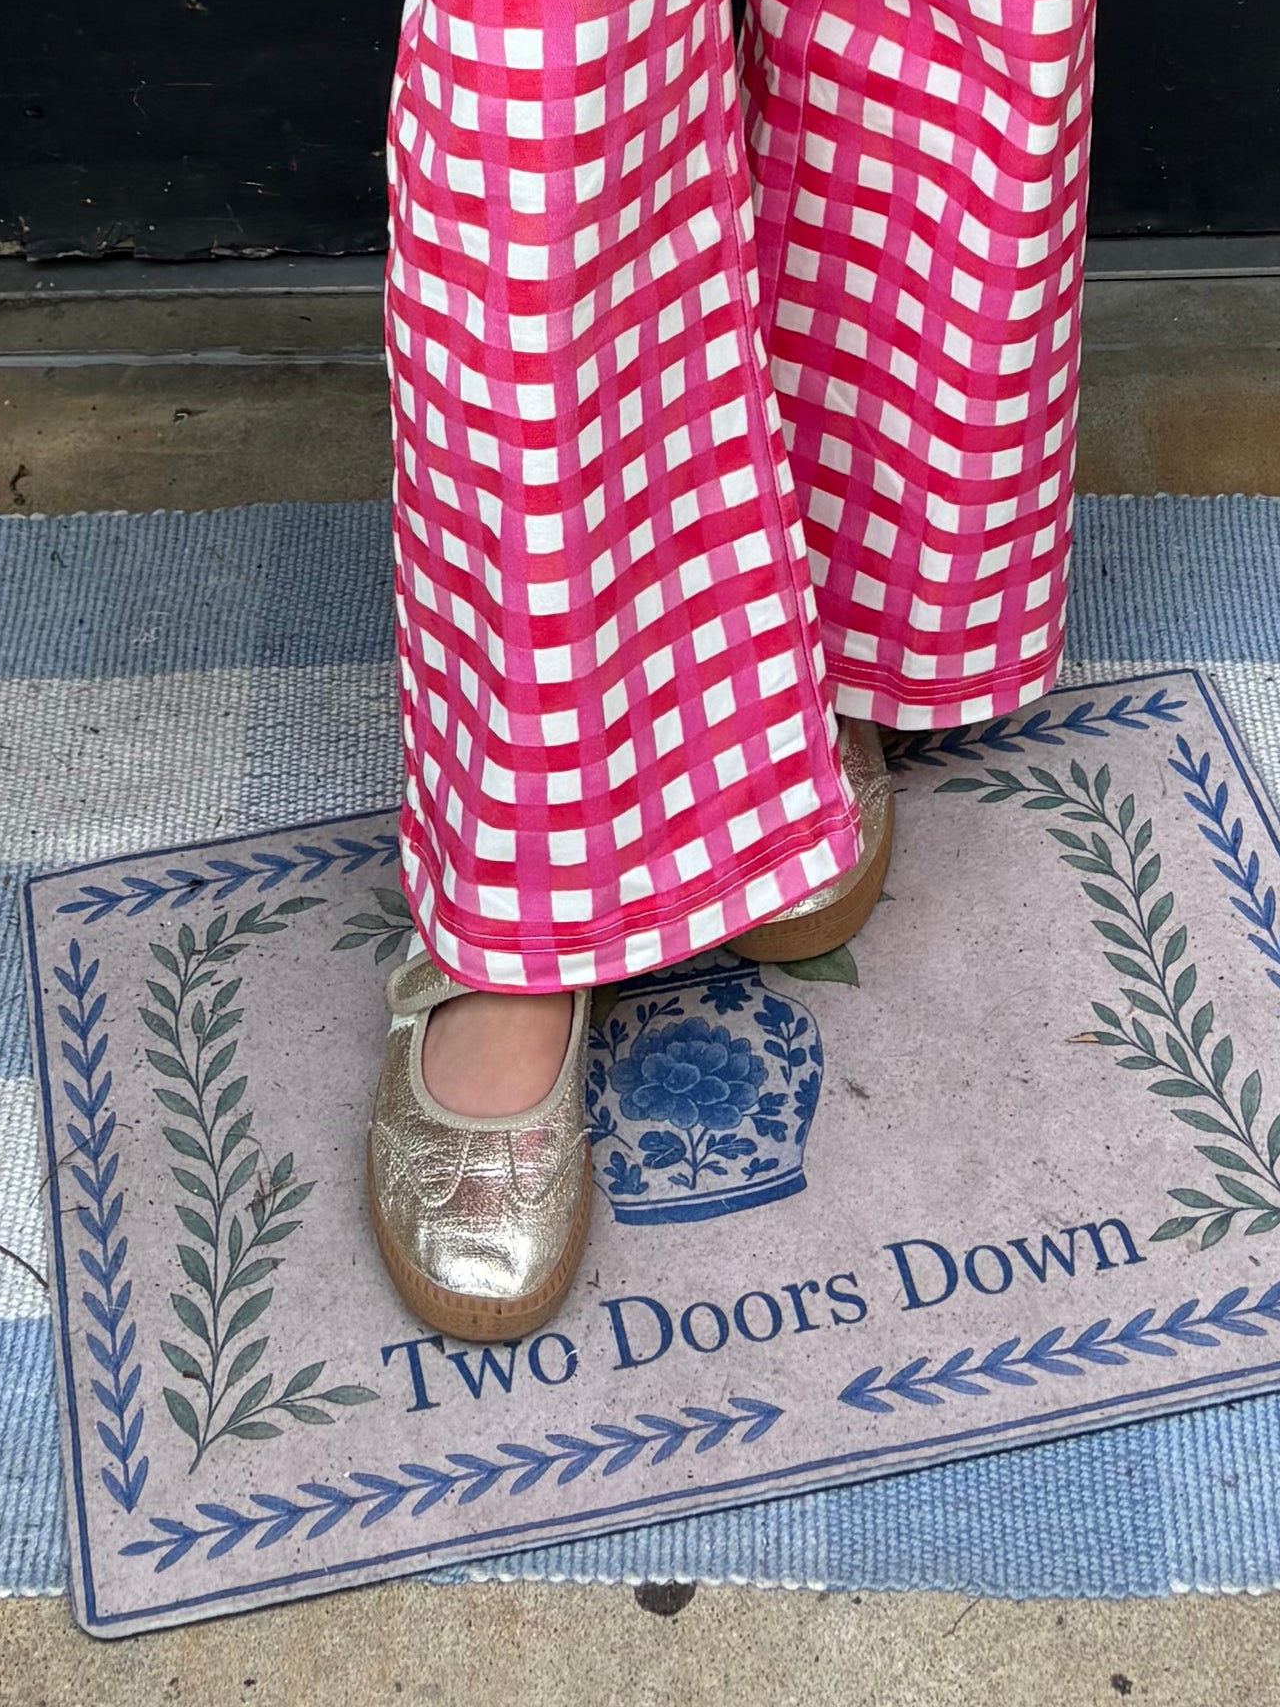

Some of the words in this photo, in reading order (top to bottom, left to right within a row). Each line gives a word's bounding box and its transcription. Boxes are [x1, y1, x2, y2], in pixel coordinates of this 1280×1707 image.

[380, 1332, 578, 1413] Two
[599, 1272, 868, 1370] Doors
[883, 1218, 1147, 1312] Down
